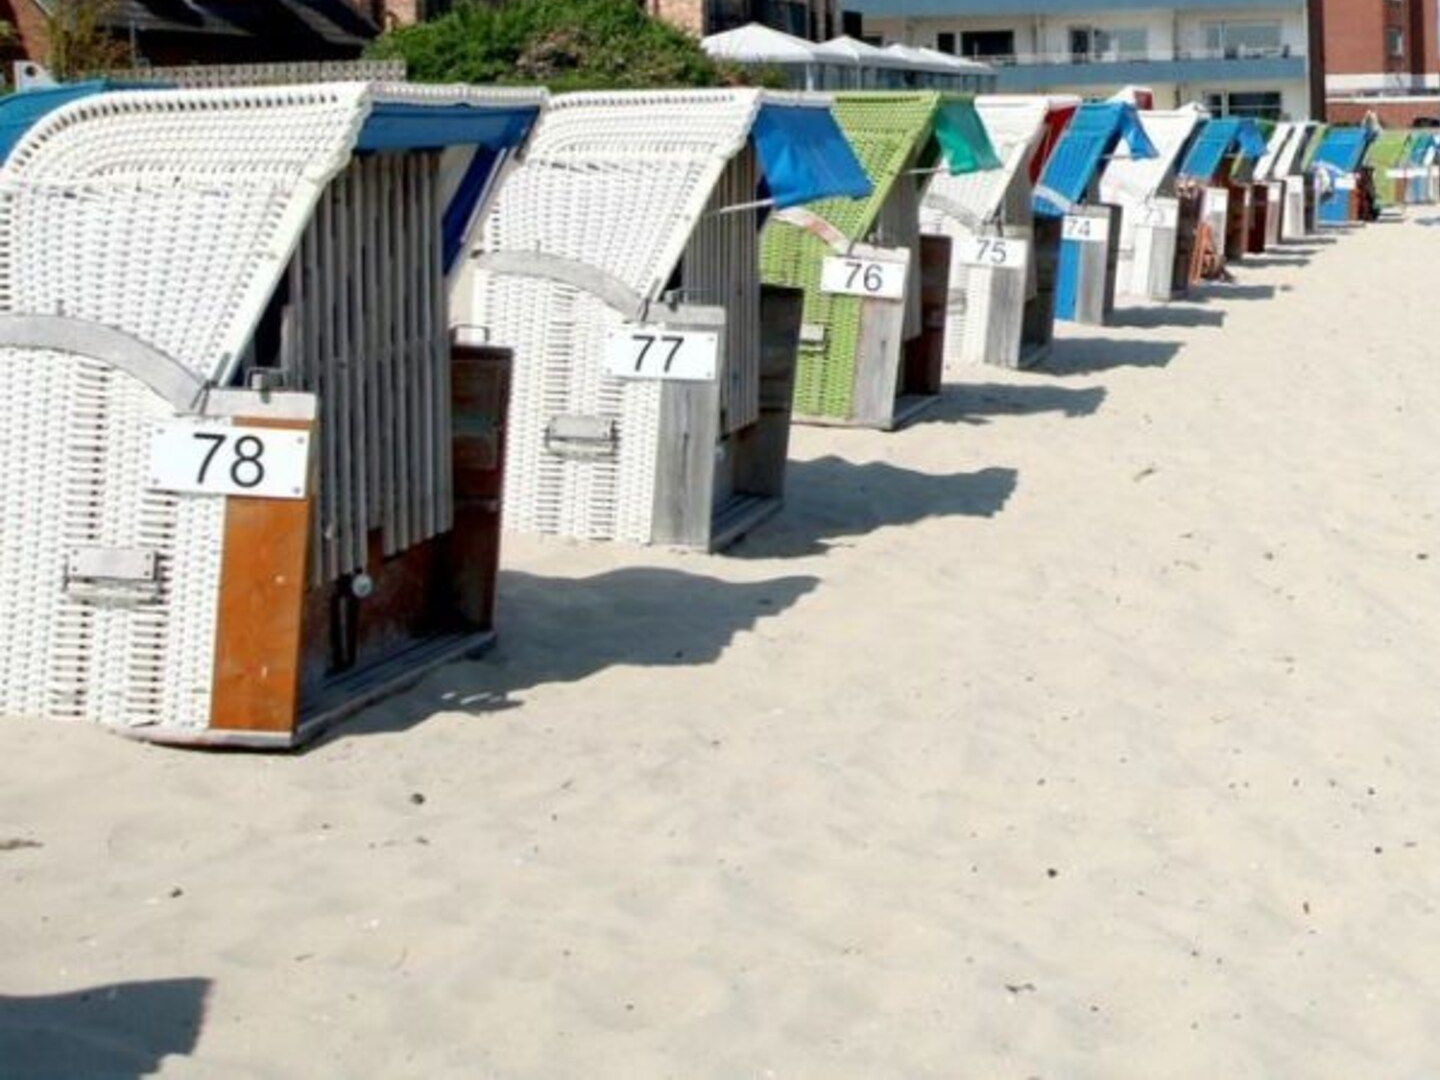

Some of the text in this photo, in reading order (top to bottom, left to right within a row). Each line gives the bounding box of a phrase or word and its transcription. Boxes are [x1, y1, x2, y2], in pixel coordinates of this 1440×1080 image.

[1068, 219, 1091, 236] 74
[976, 239, 1007, 263] 75
[845, 262, 883, 291] 76
[632, 335, 684, 372] 77
[193, 433, 265, 487] 78
